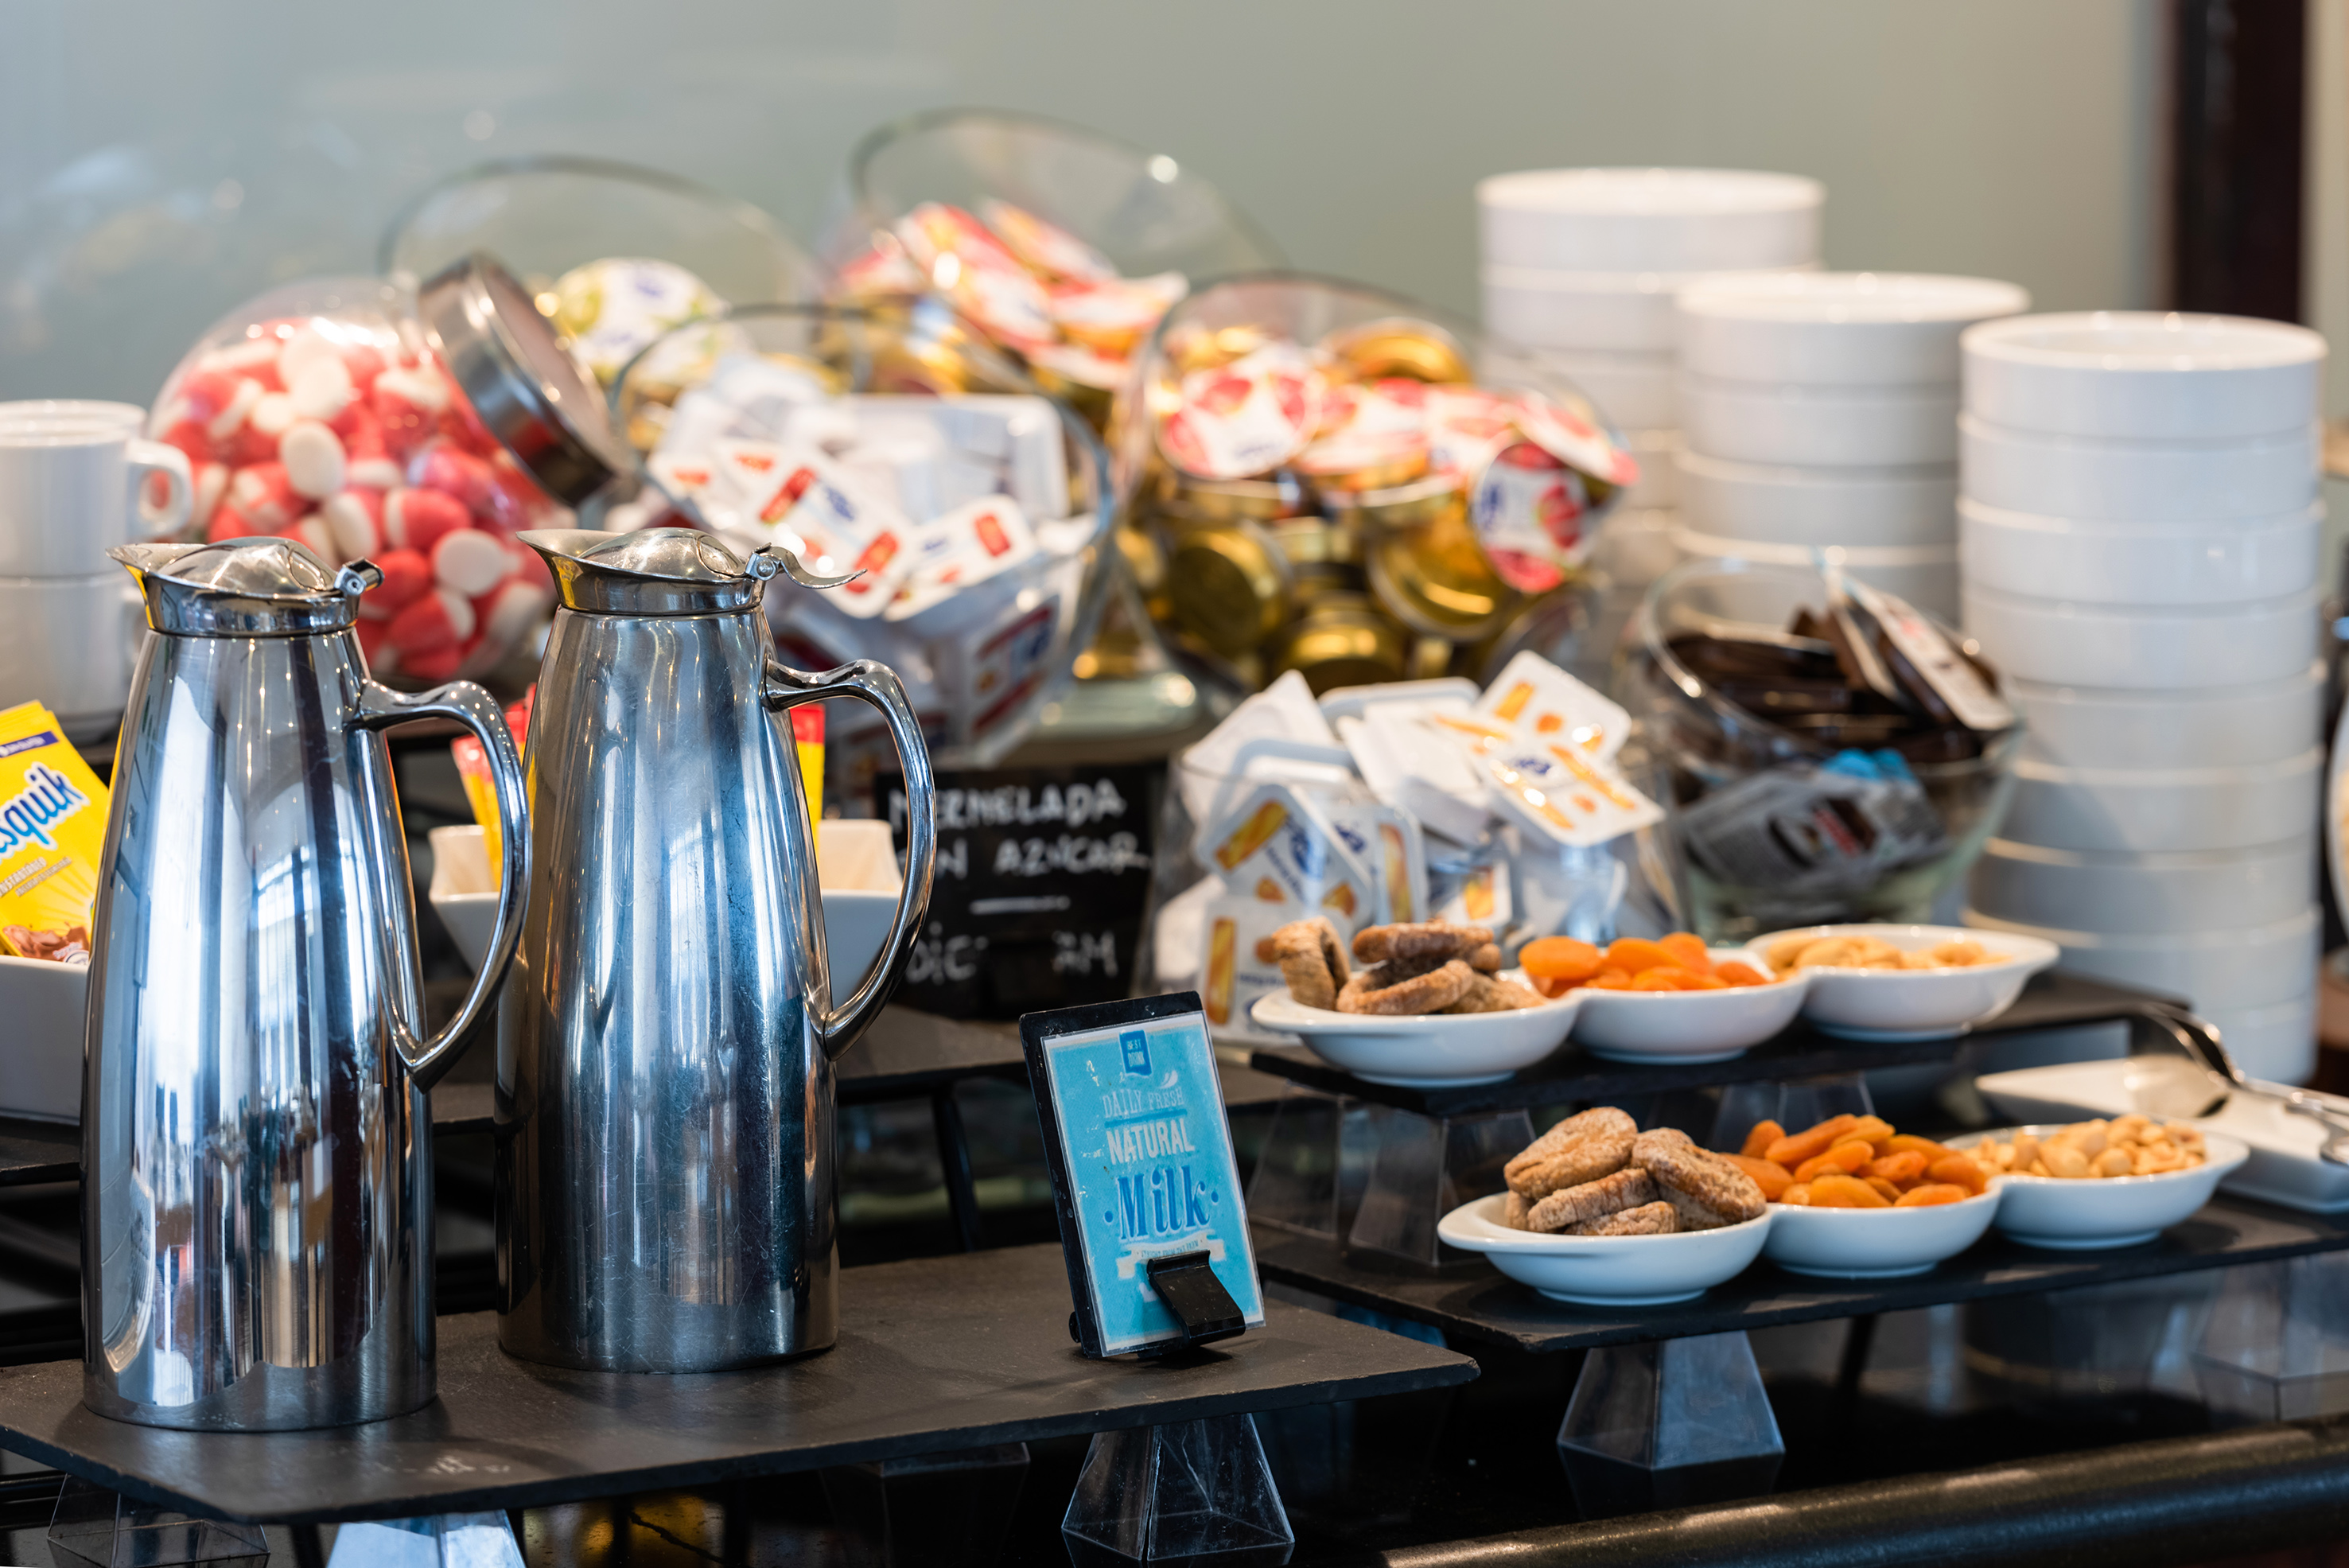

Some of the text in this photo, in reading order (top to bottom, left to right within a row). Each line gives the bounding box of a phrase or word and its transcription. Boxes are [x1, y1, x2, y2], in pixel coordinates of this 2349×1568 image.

[0, 766, 85, 854] squik
[1126, 1039, 1141, 1050] BEST
[1103, 1086, 1184, 1119] DAILY FRESH
[1106, 1118, 1195, 1165] NATURAL
[1117, 1165, 1210, 1239] Milk
